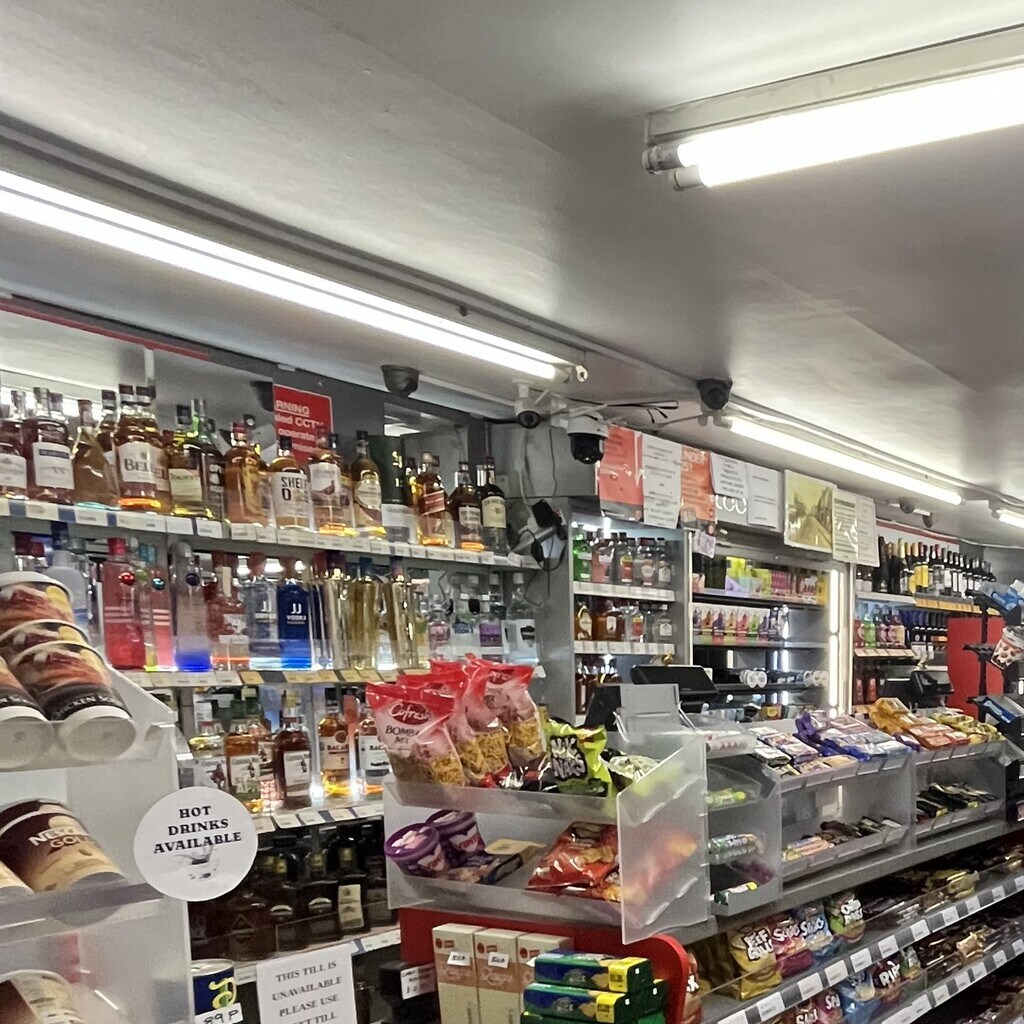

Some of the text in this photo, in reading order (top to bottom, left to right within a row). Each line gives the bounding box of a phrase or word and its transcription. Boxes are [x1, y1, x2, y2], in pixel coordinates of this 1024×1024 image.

[275, 399, 310, 416] RNING
[178, 805, 212, 819] HOT
[167, 818, 229, 837] DRINKS
[153, 831, 242, 854] AVAILABLE
[275, 960, 337, 982] THIS TILL IS
[271, 975, 343, 1002] UNAVAILABLE
[278, 993, 339, 1018] PLEASE USE
[314, 1011, 337, 1024] TILL
